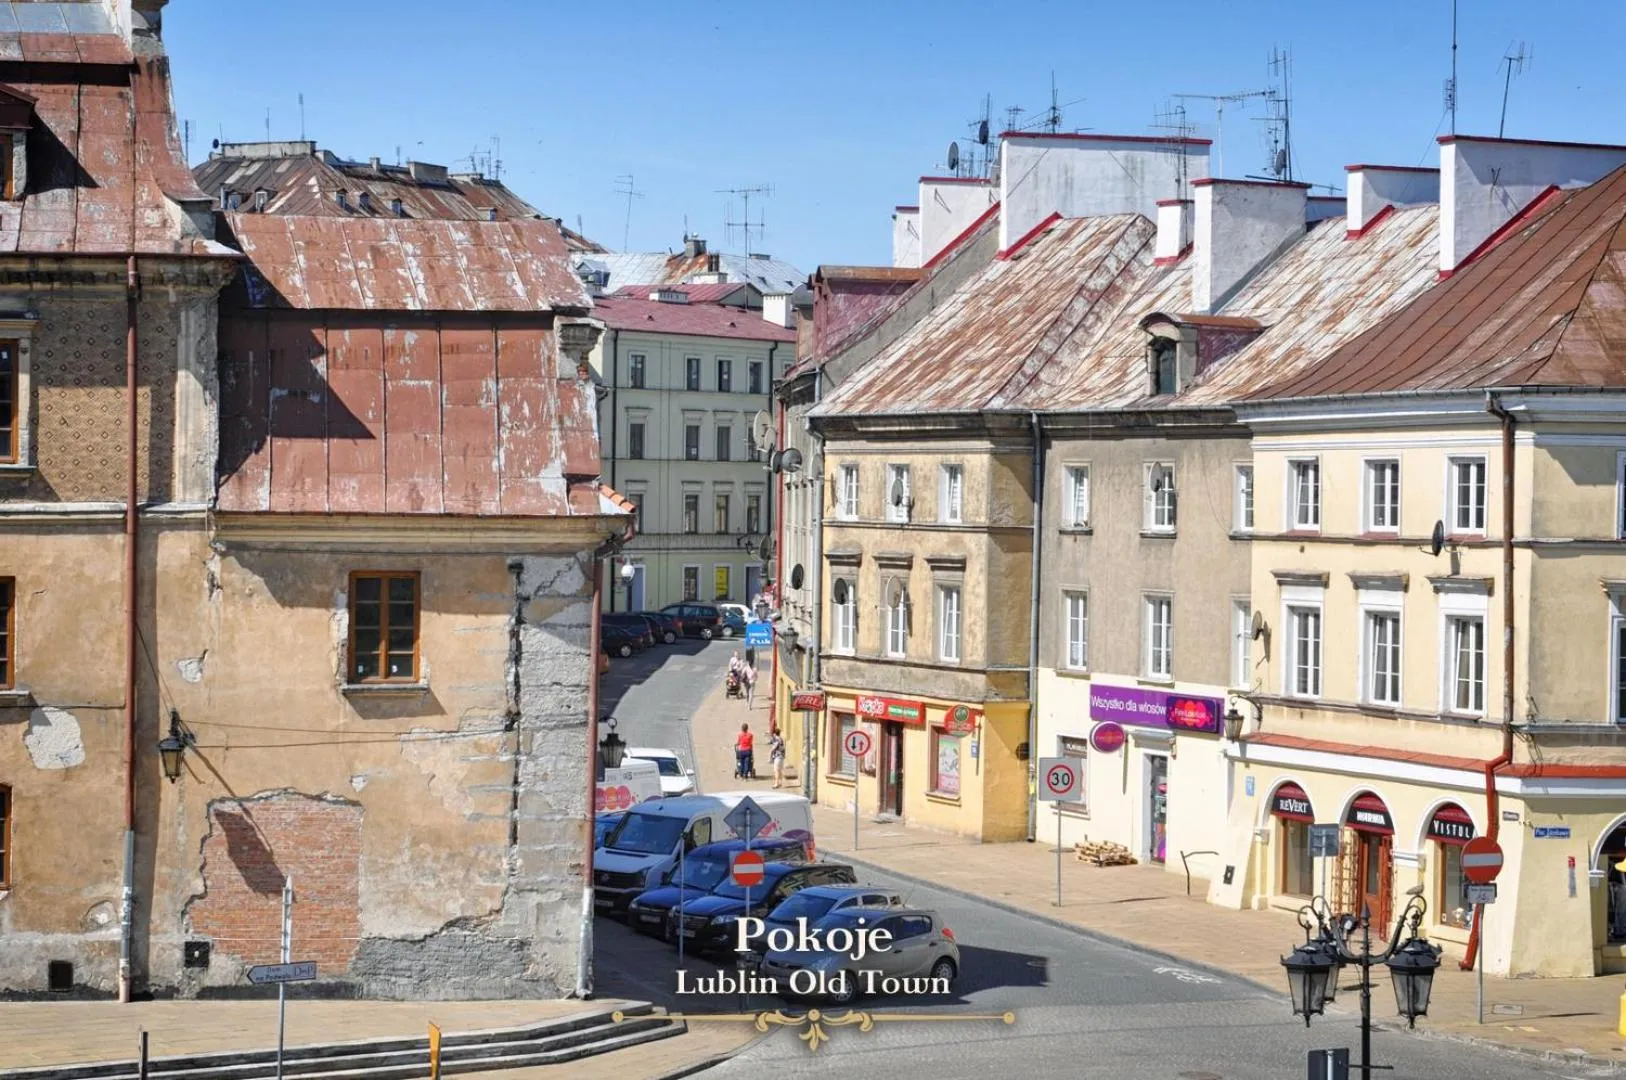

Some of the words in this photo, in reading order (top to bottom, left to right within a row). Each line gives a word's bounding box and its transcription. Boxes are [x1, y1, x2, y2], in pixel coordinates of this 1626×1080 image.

[1091, 695, 1124, 711] Wszystko
[1126, 699, 1136, 711] dla
[1139, 701, 1167, 715] włosów
[1051, 772, 1070, 786] 30
